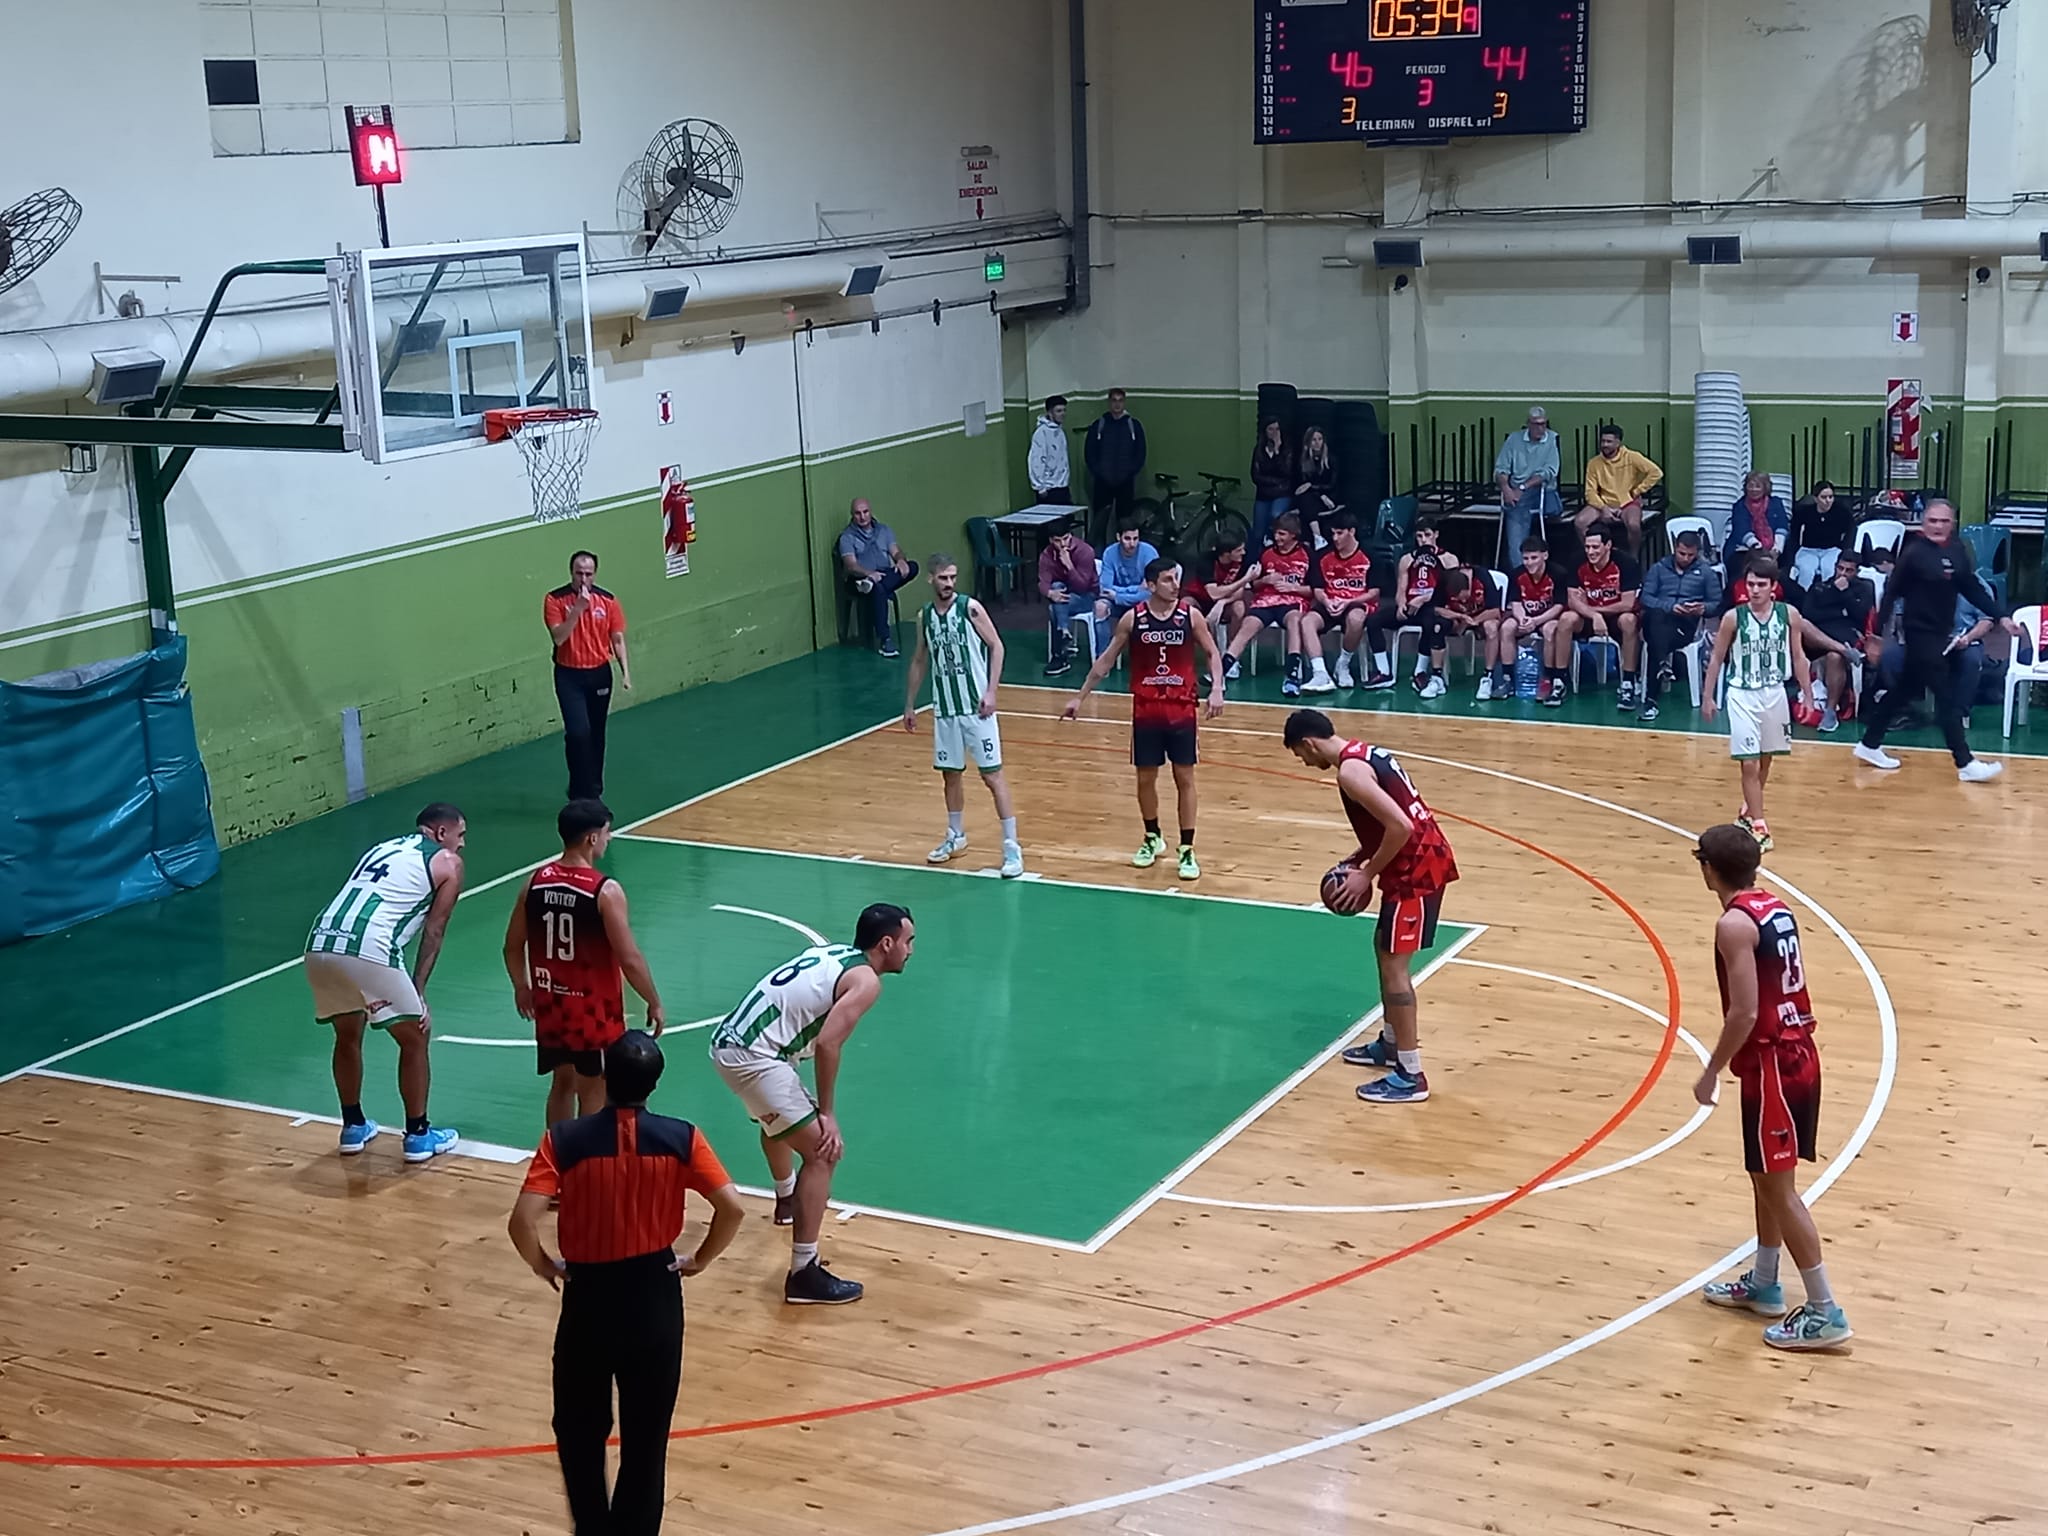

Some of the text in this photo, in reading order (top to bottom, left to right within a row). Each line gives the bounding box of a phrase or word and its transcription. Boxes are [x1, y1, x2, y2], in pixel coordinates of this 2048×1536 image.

[1577, 34, 1583, 42] 7
[1330, 51, 1373, 88] 46
[1483, 47, 1527, 80] 44
[1574, 64, 1584, 73] 10
[1262, 75, 1273, 84] 10
[1574, 75, 1584, 83] 11
[1262, 85, 1273, 94] 11
[1418, 79, 1433, 107] 3
[1574, 85, 1584, 93] 12
[1262, 96, 1273, 104] 12
[1493, 92, 1508, 118] 3
[1341, 97, 1357, 124] 3
[1573, 116, 1583, 125] 15
[1262, 127, 1273, 136] 15
[967, 160, 988, 171] SALIDA
[974, 173, 982, 183] DE
[1418, 566, 1428, 580] 16
[1141, 630, 1184, 644] COLON
[1159, 646, 1167, 663] 5
[1759, 652, 1771, 669] 10
[982, 738, 993, 753] 15
[352, 847, 402, 883] 14
[542, 911, 575, 962] 19
[770, 956, 820, 986] 8
[1777, 935, 1804, 995] 23
